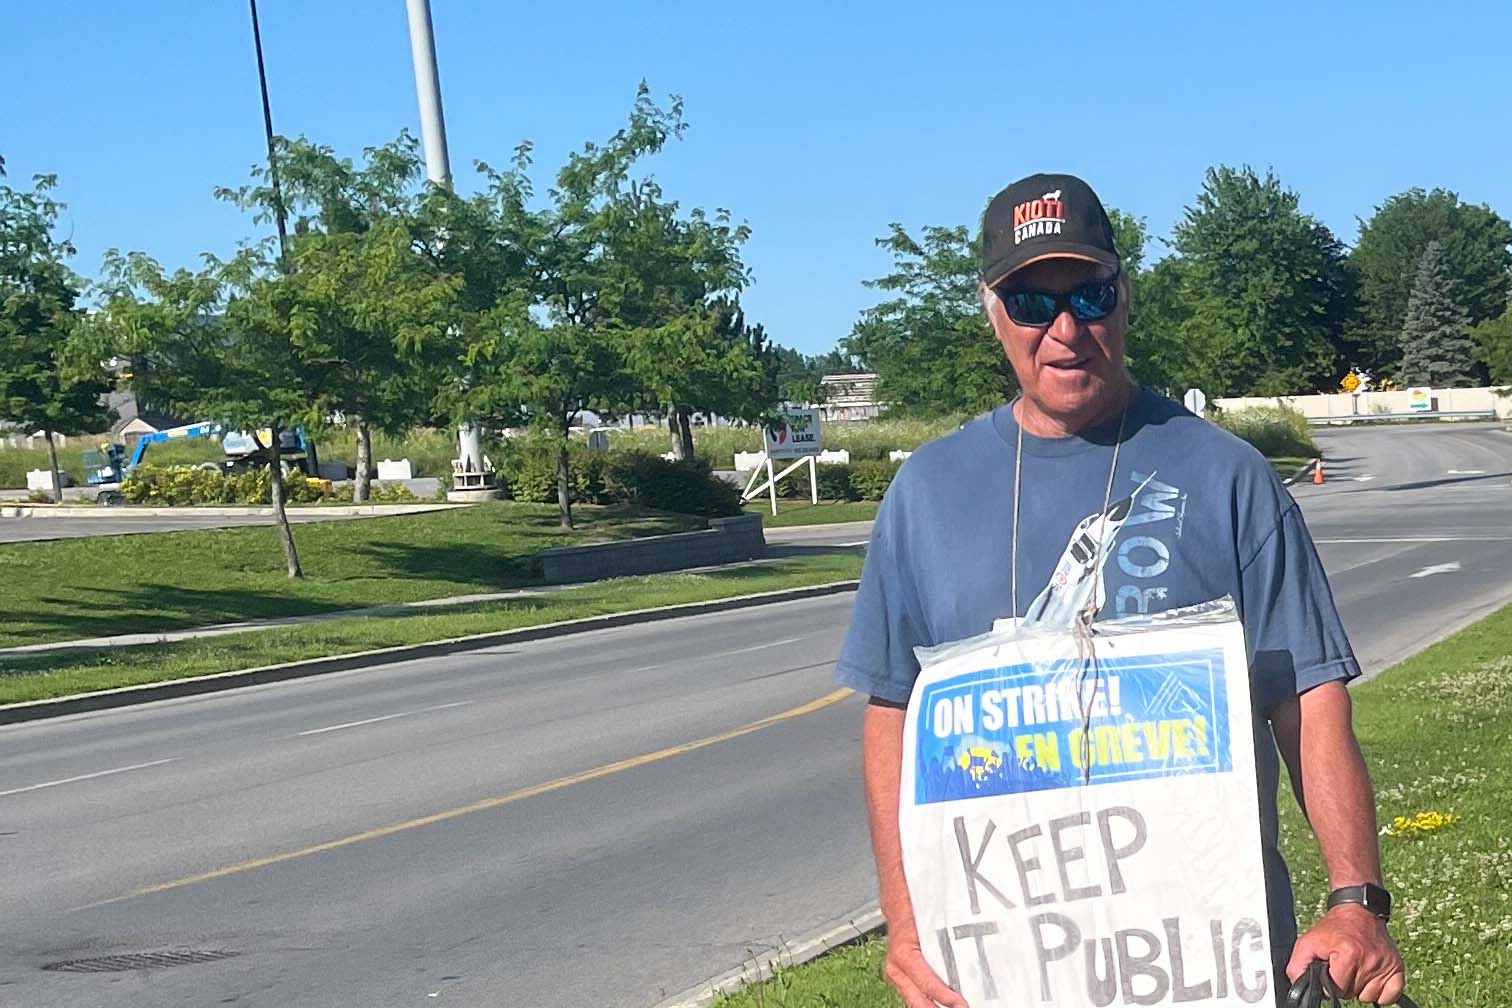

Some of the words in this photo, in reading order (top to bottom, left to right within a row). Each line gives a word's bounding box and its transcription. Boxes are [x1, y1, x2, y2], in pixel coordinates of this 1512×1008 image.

[1013, 200, 1064, 229] KIOTI
[1014, 220, 1062, 245] CANADA
[934, 694, 975, 738] ON
[982, 676, 1122, 731] STRIKE!
[1014, 732, 1060, 772] EN
[953, 806, 1148, 914] KEEP
[935, 921, 1001, 1002] IT
